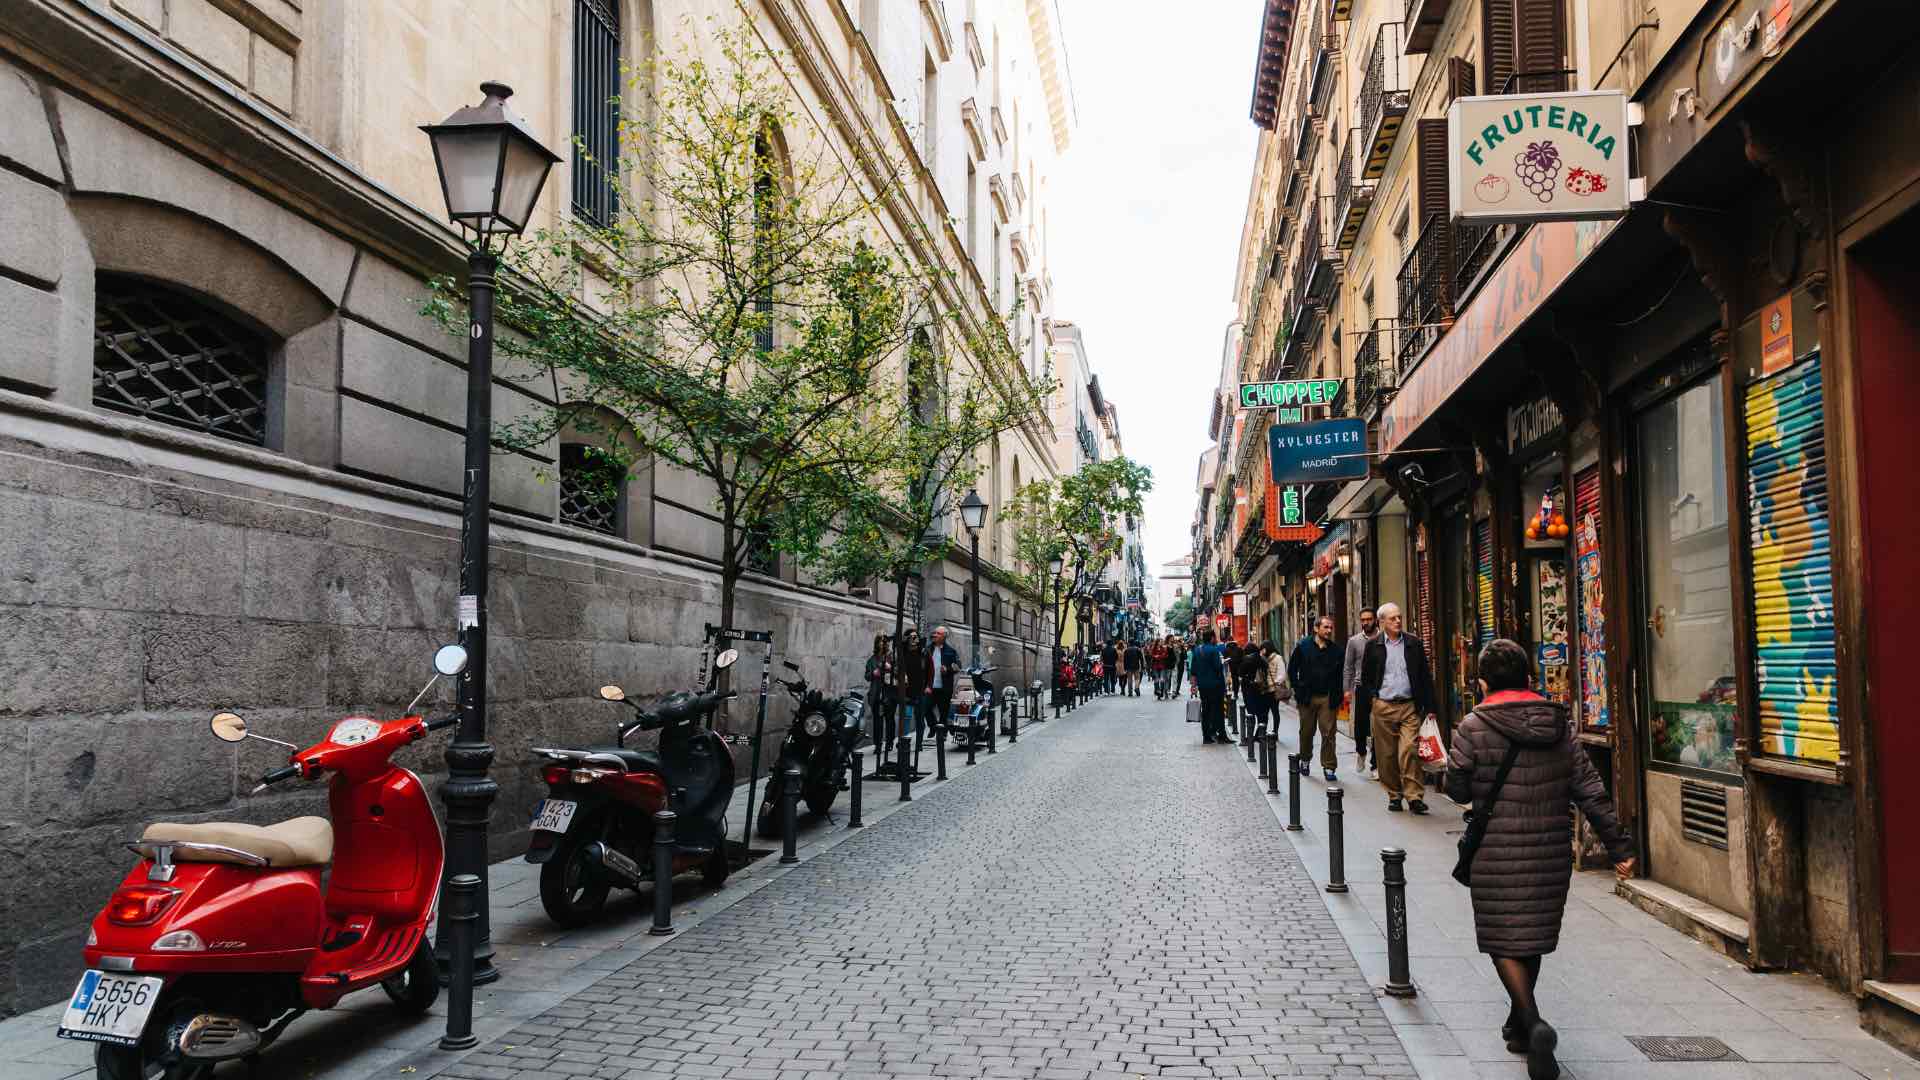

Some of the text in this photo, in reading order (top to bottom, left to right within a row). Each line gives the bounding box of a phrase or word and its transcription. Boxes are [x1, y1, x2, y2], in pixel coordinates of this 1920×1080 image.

[1466, 105, 1616, 166] FRUTERIA
[1241, 381, 1339, 406] CHOPPER
[1302, 458, 1338, 469] MADRID
[94, 978, 151, 1006] 5656
[82, 1003, 128, 1027] HKY
